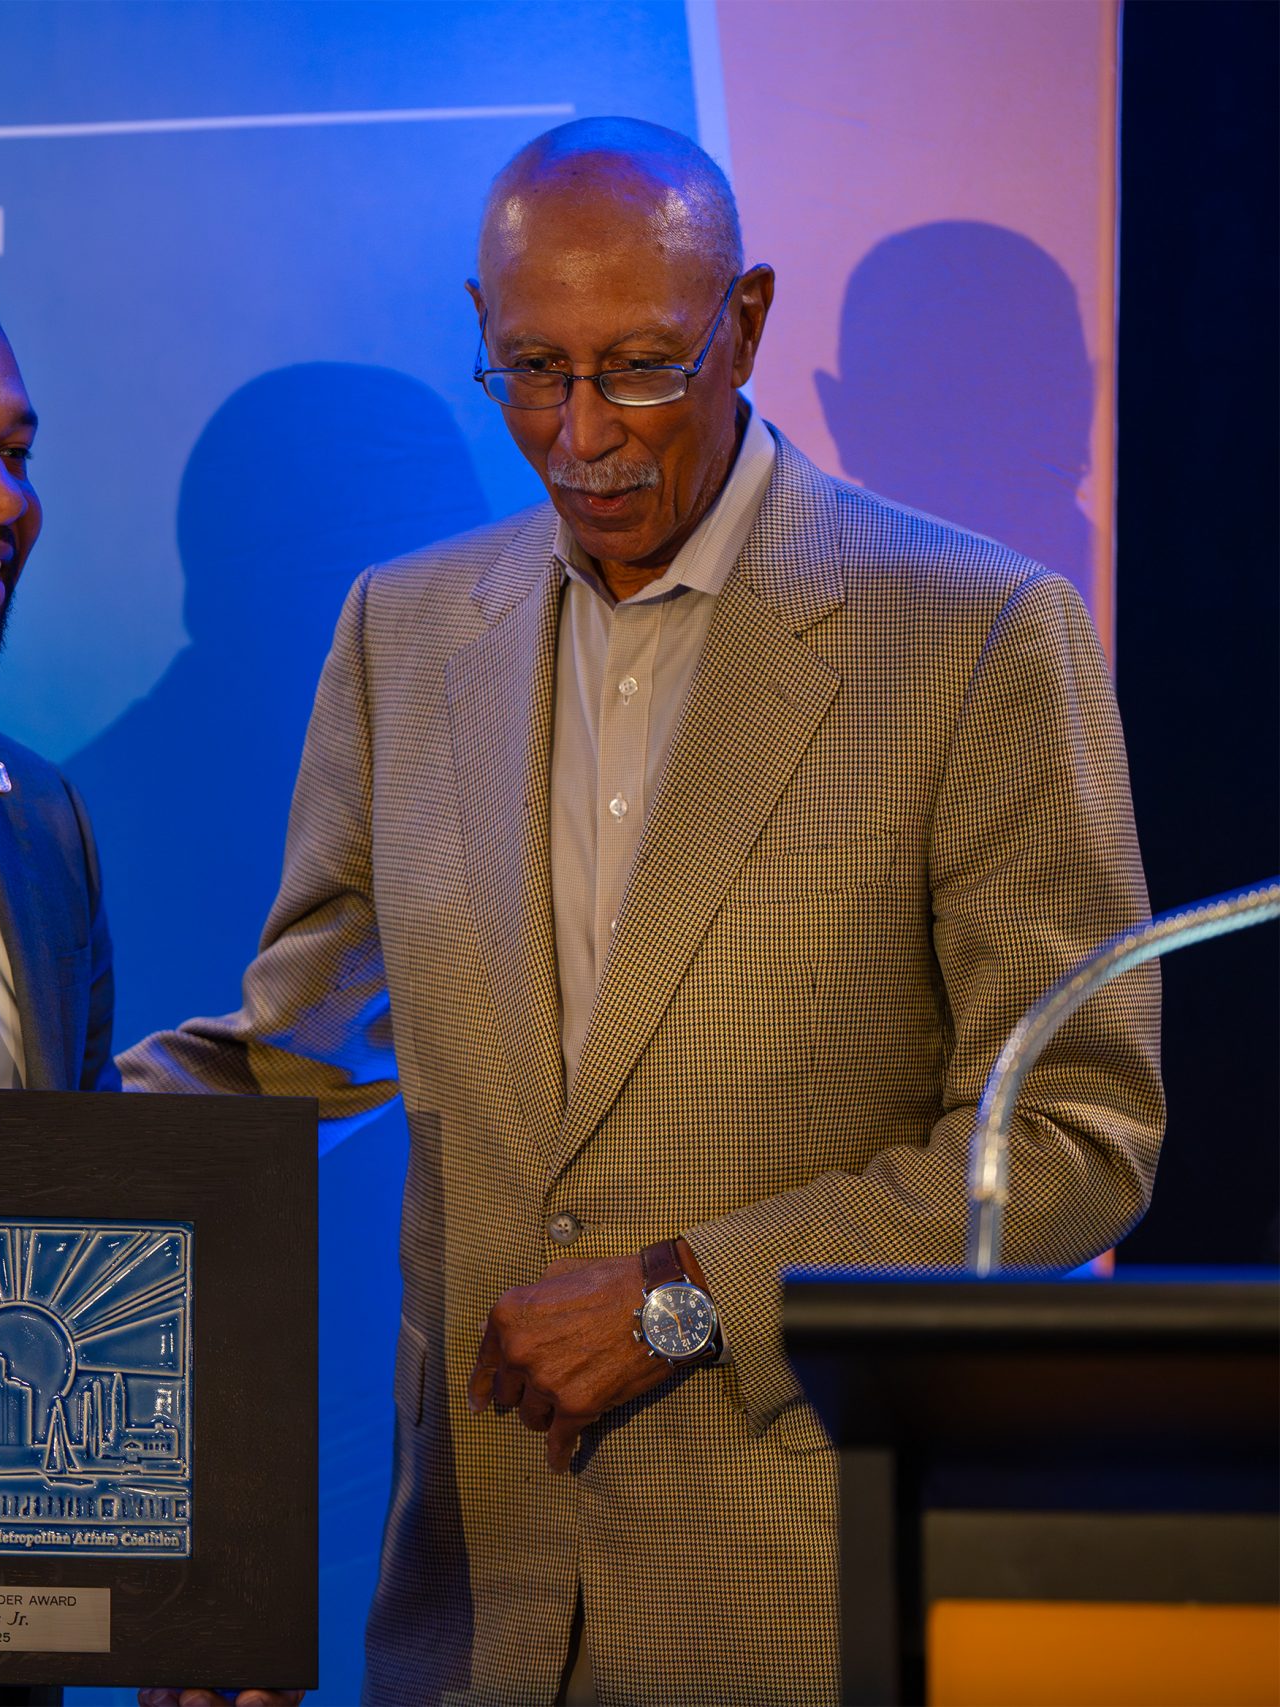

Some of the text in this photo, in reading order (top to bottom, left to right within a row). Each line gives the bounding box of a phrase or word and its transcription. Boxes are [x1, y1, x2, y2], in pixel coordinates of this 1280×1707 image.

[121, 1532, 180, 1547] Coalition
[28, 1595, 77, 1607] AWARD
[6, 1611, 29, 1626] Jr.
